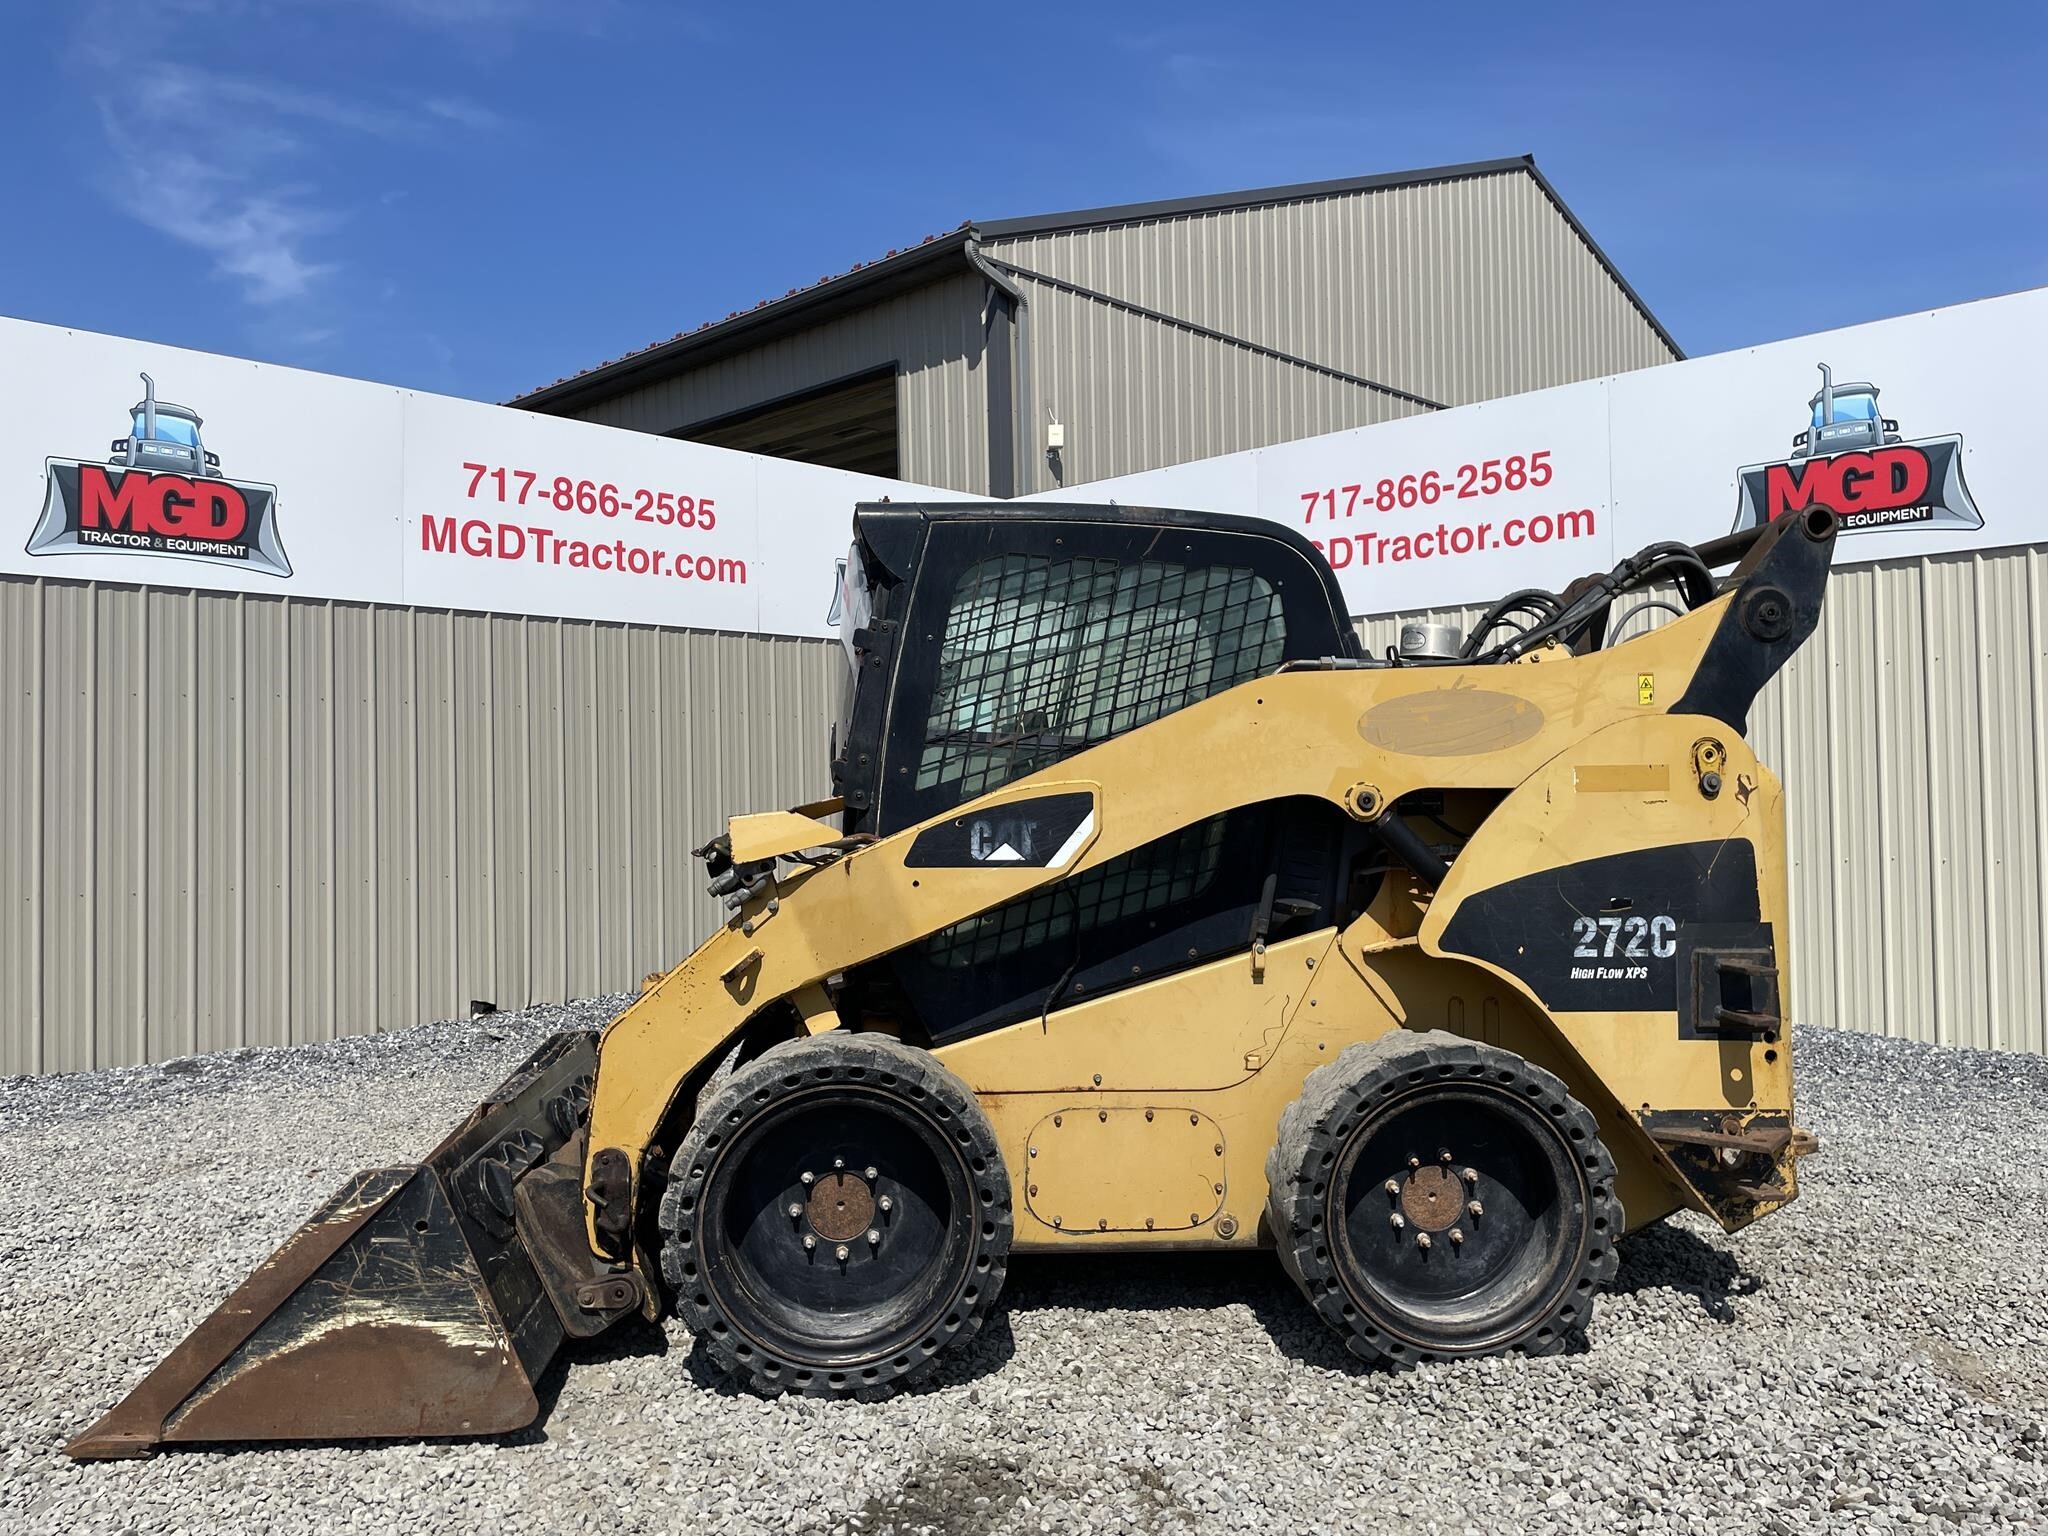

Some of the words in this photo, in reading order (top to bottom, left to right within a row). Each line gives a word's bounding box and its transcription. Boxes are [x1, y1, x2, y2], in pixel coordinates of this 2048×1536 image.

[81, 468, 246, 540] MGD
[462, 462, 716, 531] 717-866-2585
[1301, 450, 1553, 525] 717-866-2585
[1766, 447, 1930, 522] MGD
[1847, 506, 1929, 527] EQUIPMENT
[81, 530, 151, 548] TRACTOR
[154, 537, 164, 549] &
[166, 539, 246, 556] EQUIPMENT
[421, 514, 747, 584] MGDTractor.com
[1311, 508, 1595, 570] DTractor.com
[1573, 915, 1677, 958] 272C
[1625, 967, 1648, 979] XPS
